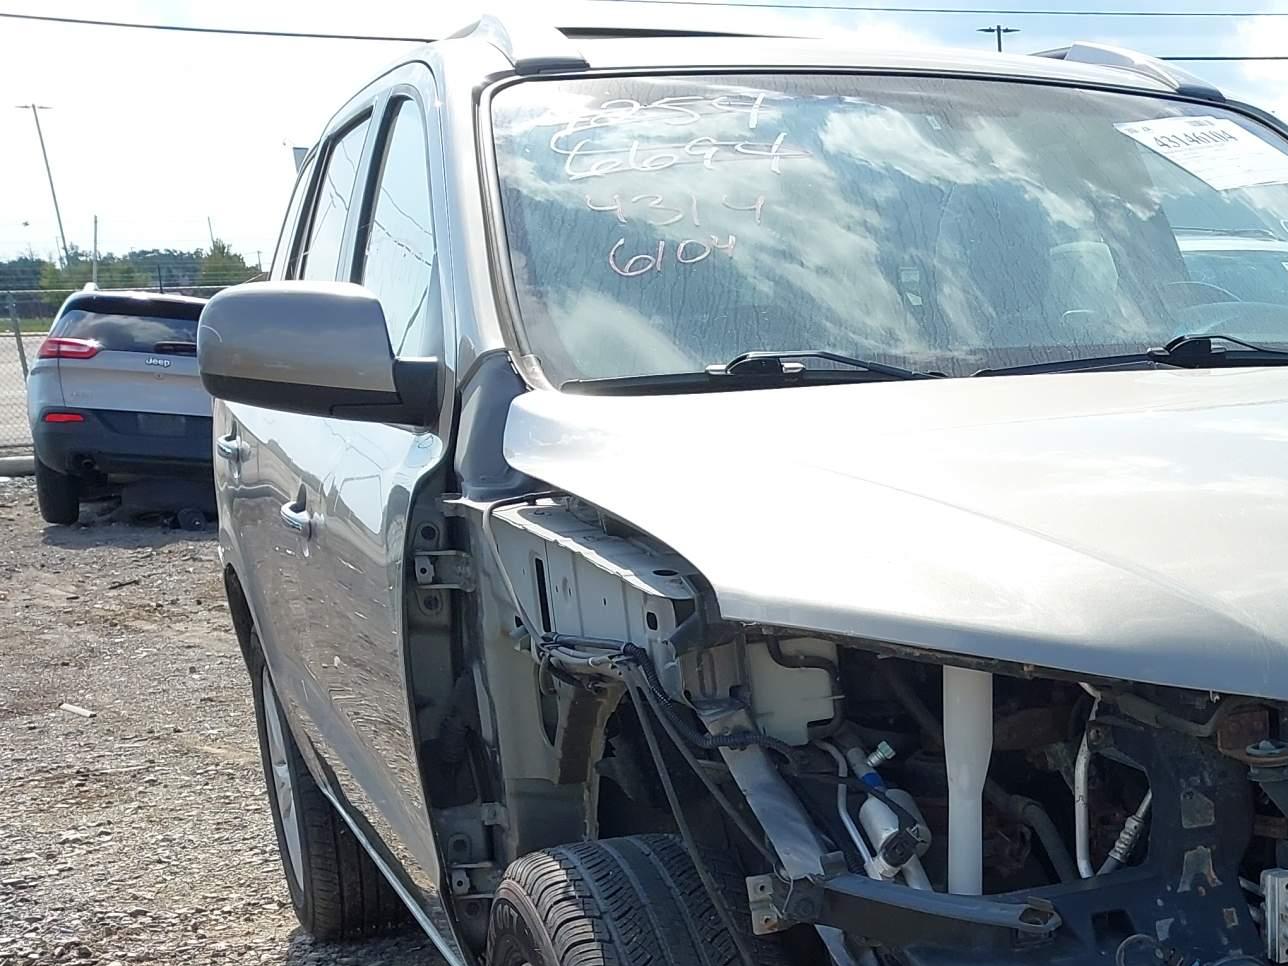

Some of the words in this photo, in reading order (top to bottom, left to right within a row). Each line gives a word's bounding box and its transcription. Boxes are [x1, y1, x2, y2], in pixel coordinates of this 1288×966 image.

[584, 194, 768, 226] 4314
[609, 234, 736, 277] 6104
[145, 357, 171, 368] Jeep
